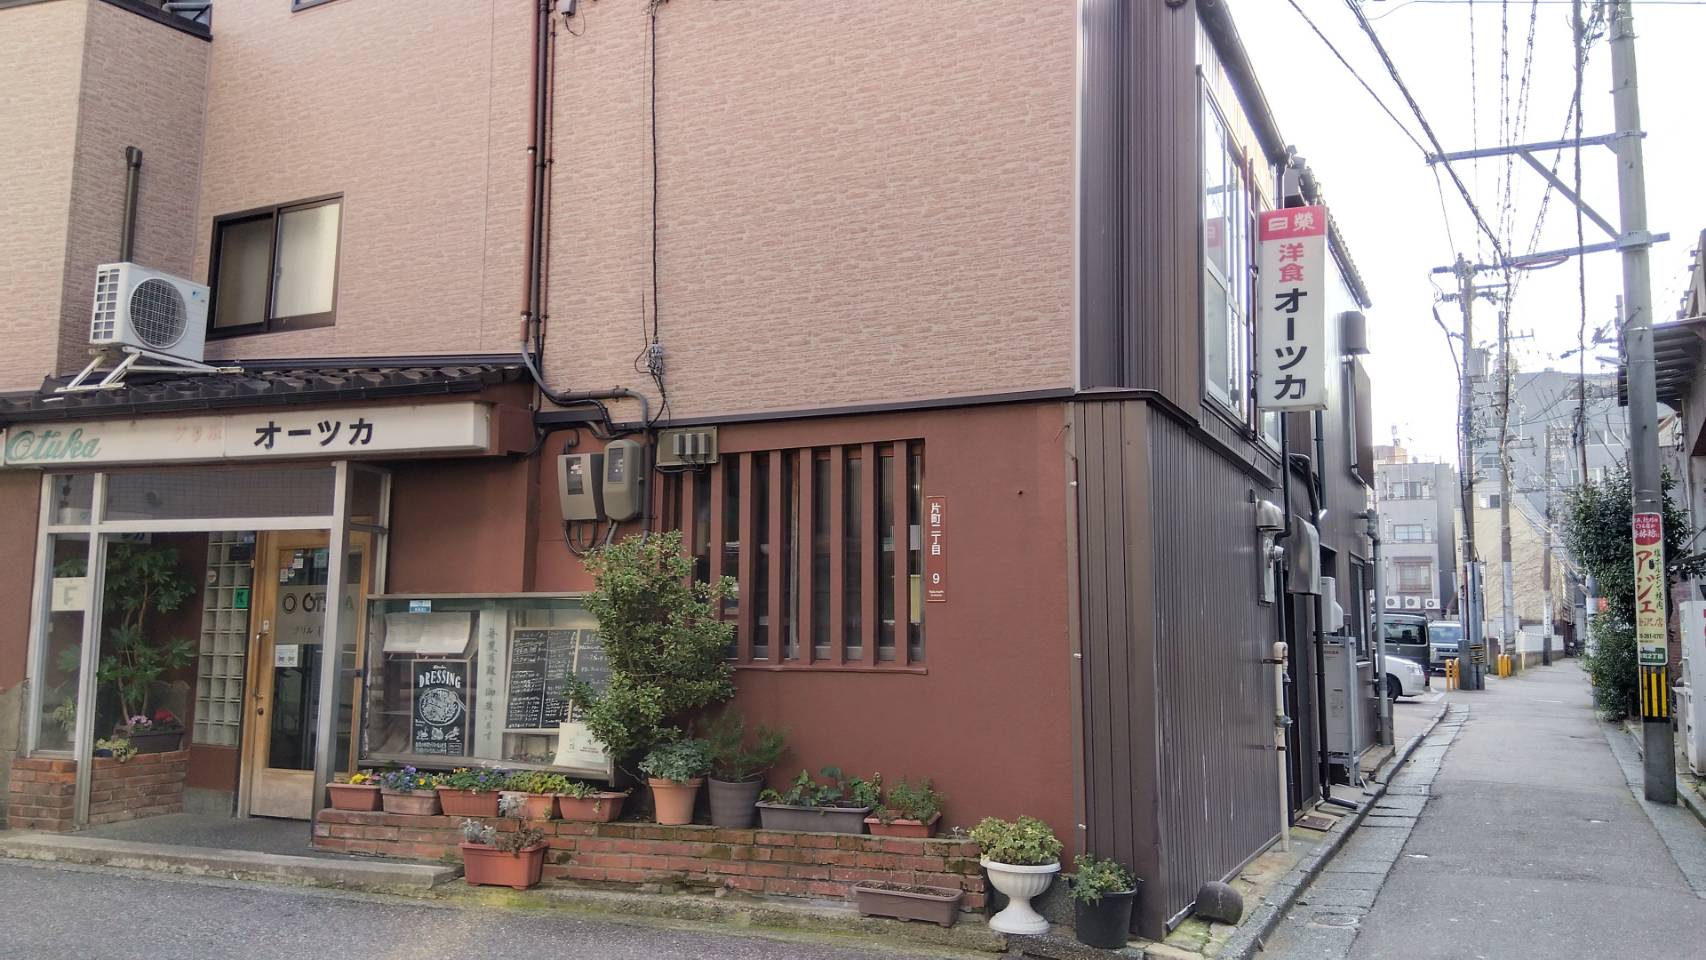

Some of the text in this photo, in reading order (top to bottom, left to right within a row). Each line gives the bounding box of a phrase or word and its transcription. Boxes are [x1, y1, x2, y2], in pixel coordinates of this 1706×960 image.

[1279, 243, 1304, 283] 洋食
[1274, 288, 1308, 400] オーツカ
[254, 418, 373, 449] オーツカ
[930, 503, 941, 555] 片町二丁目
[932, 573, 940, 584] 9
[419, 670, 461, 688] DRESSING
